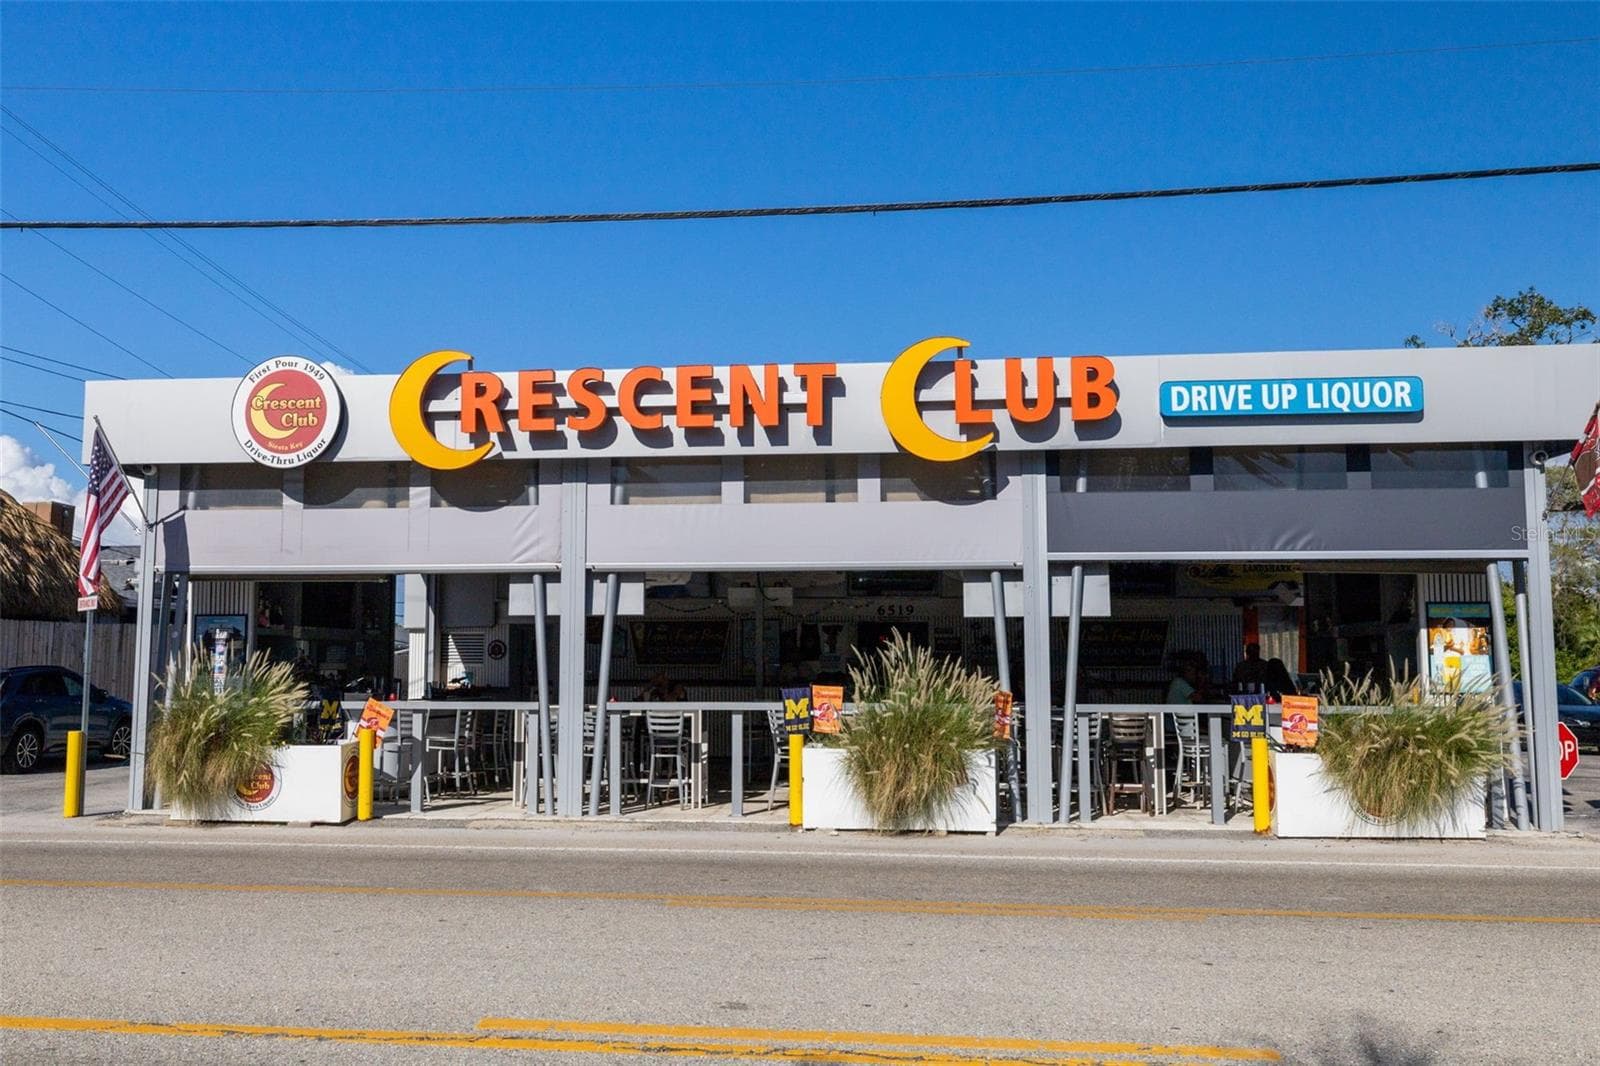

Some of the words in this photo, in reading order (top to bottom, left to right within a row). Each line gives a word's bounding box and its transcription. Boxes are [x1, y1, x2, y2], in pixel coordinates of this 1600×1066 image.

[248, 365, 271, 383] First
[275, 360, 298, 368] Pour
[304, 363, 325, 380] 1949
[251, 395, 321, 410] Crescent
[1171, 384, 1252, 411] DRIVE
[1261, 383, 1297, 409] UP
[1307, 381, 1412, 411] LIQUOR
[281, 412, 318, 427] Club
[244, 439, 294, 465] Drive-Thru
[296, 439, 326, 460] Liquor
[877, 605, 914, 616] 6519
[320, 699, 339, 718] M
[785, 698, 809, 719] M
[1233, 705, 1264, 726] M
